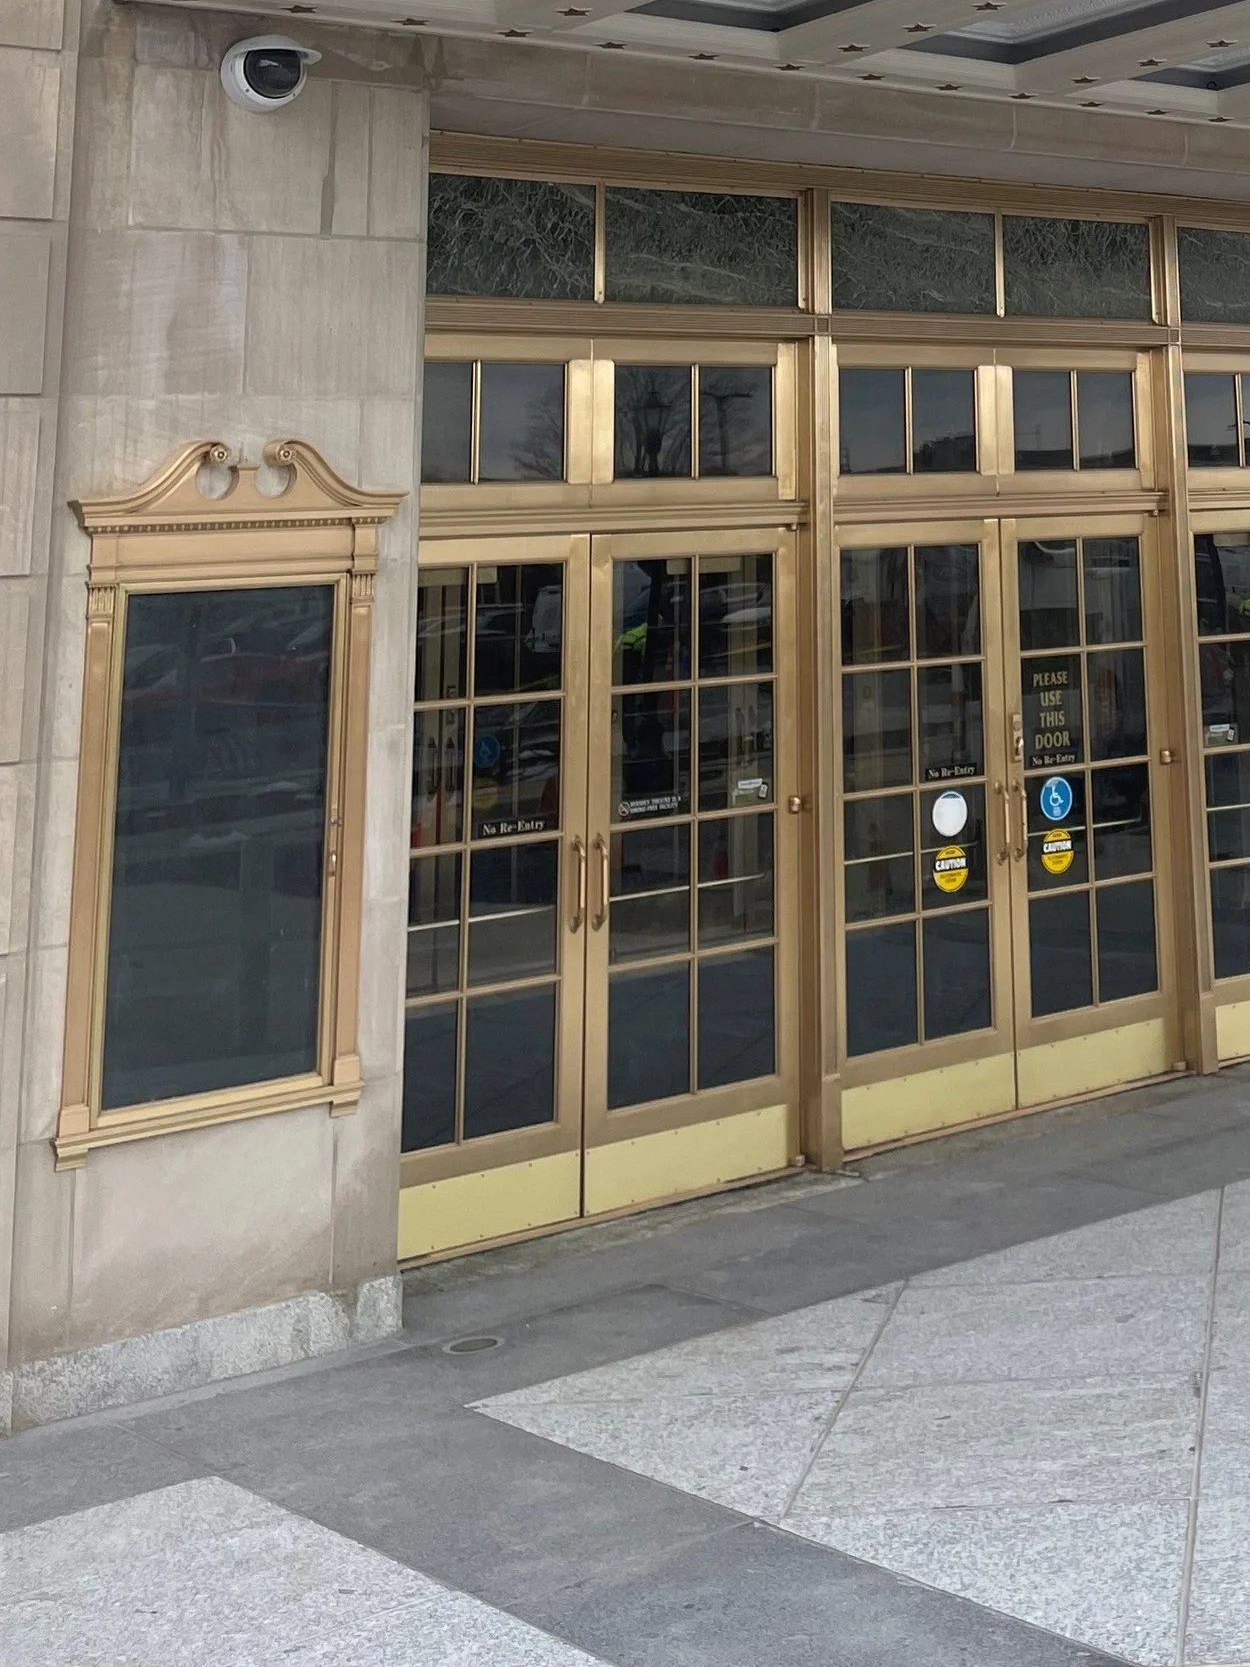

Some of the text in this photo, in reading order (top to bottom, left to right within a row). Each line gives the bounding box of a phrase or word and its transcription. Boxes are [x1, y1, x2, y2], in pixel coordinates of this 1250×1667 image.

[1033, 670, 1068, 687] PLEASE
[1041, 690, 1063, 707] USE
[1040, 711, 1065, 729] THIS
[1035, 731, 1070, 750] DOOR
[1032, 754, 1075, 766] No Re-Entry
[928, 765, 975, 779] No Re-Entry
[483, 820, 545, 836] No Re-Entry
[935, 857, 967, 871] CAUTION
